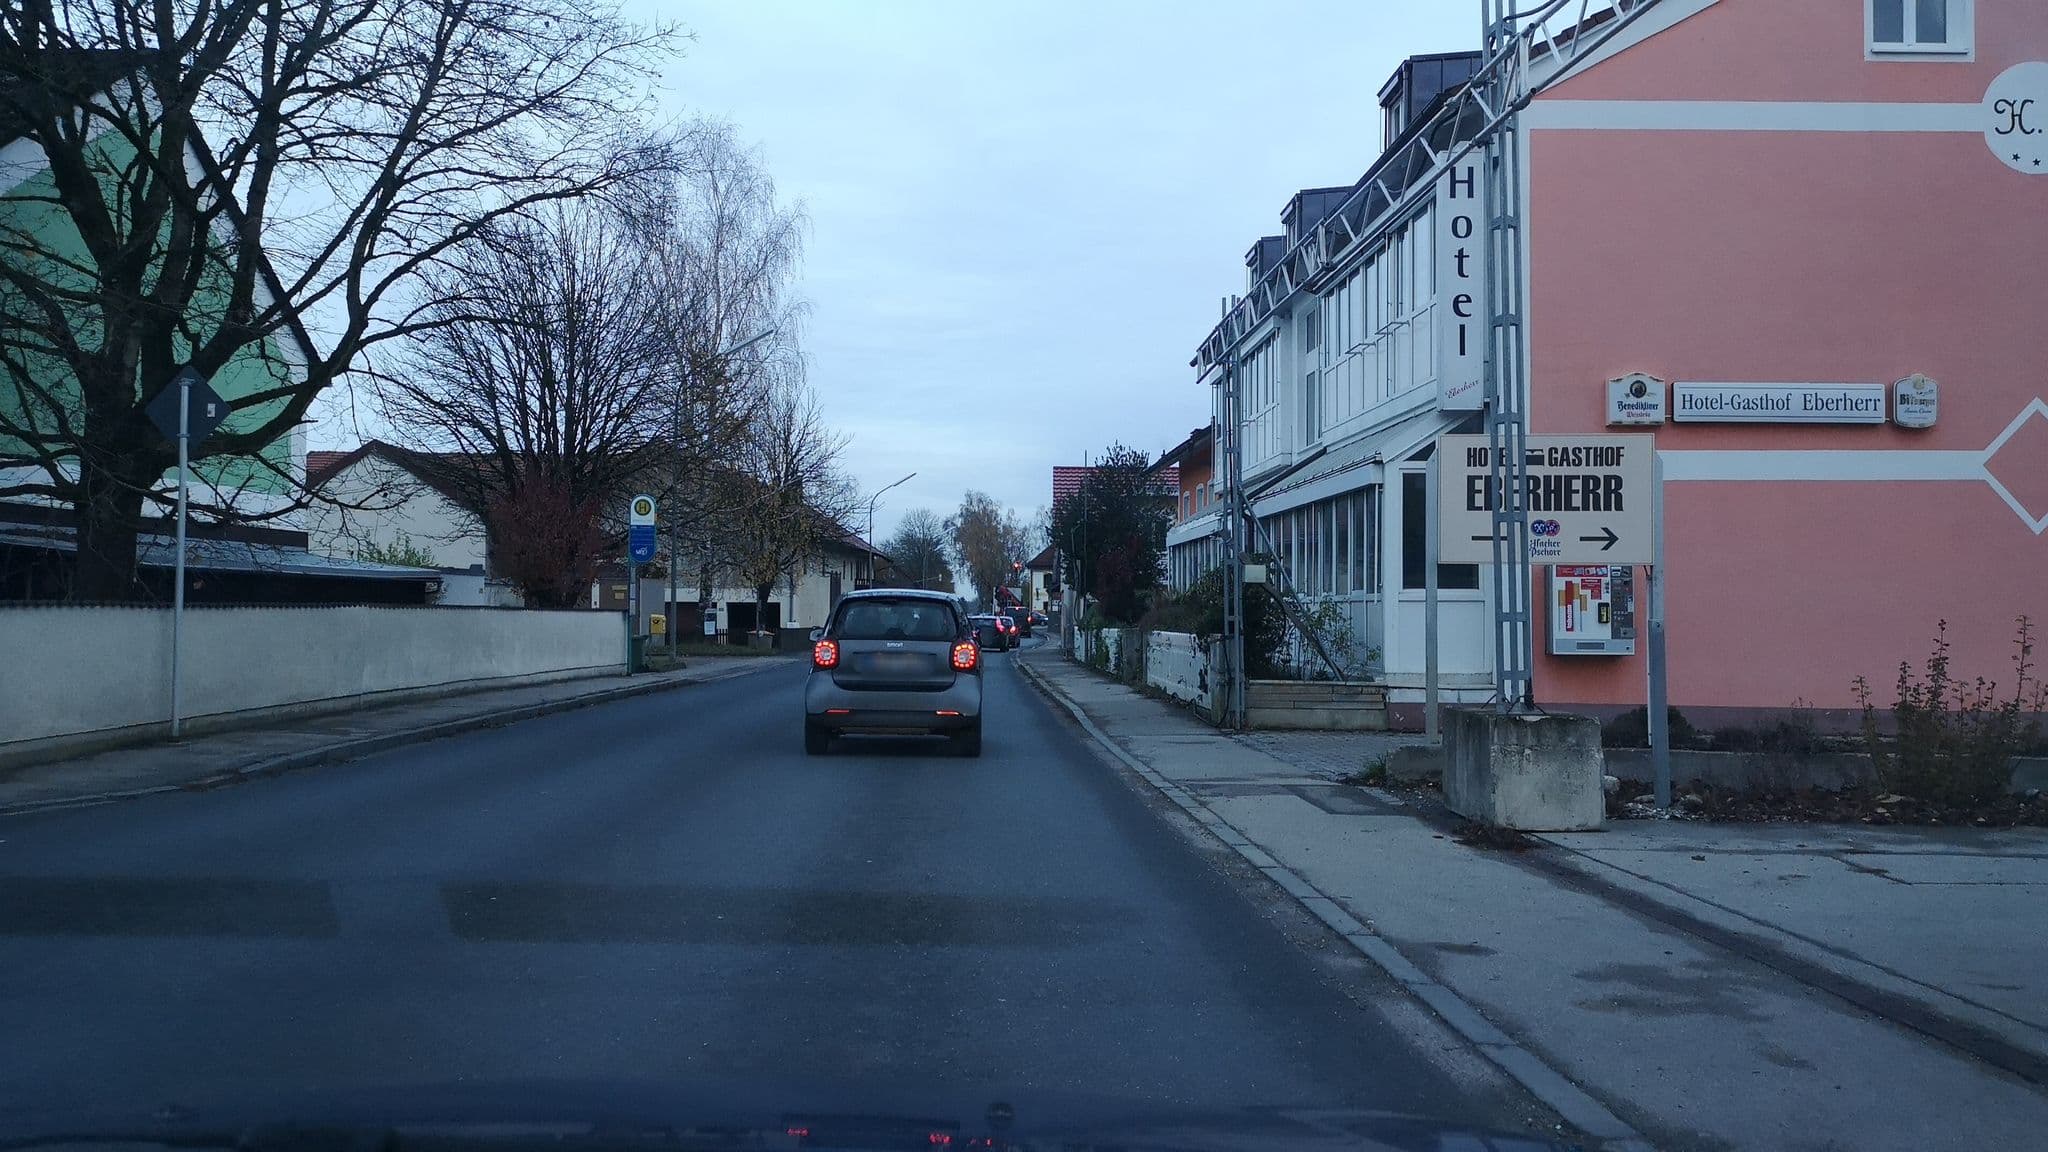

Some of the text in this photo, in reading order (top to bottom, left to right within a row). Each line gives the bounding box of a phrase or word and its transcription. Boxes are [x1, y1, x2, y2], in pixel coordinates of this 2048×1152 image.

[1448, 165, 1475, 356] Hotel
[1681, 393, 1881, 412] Hotel-Gasthof Eberherr
[1466, 446, 1625, 467] HOE GASTHOF
[638, 502, 647, 513] H
